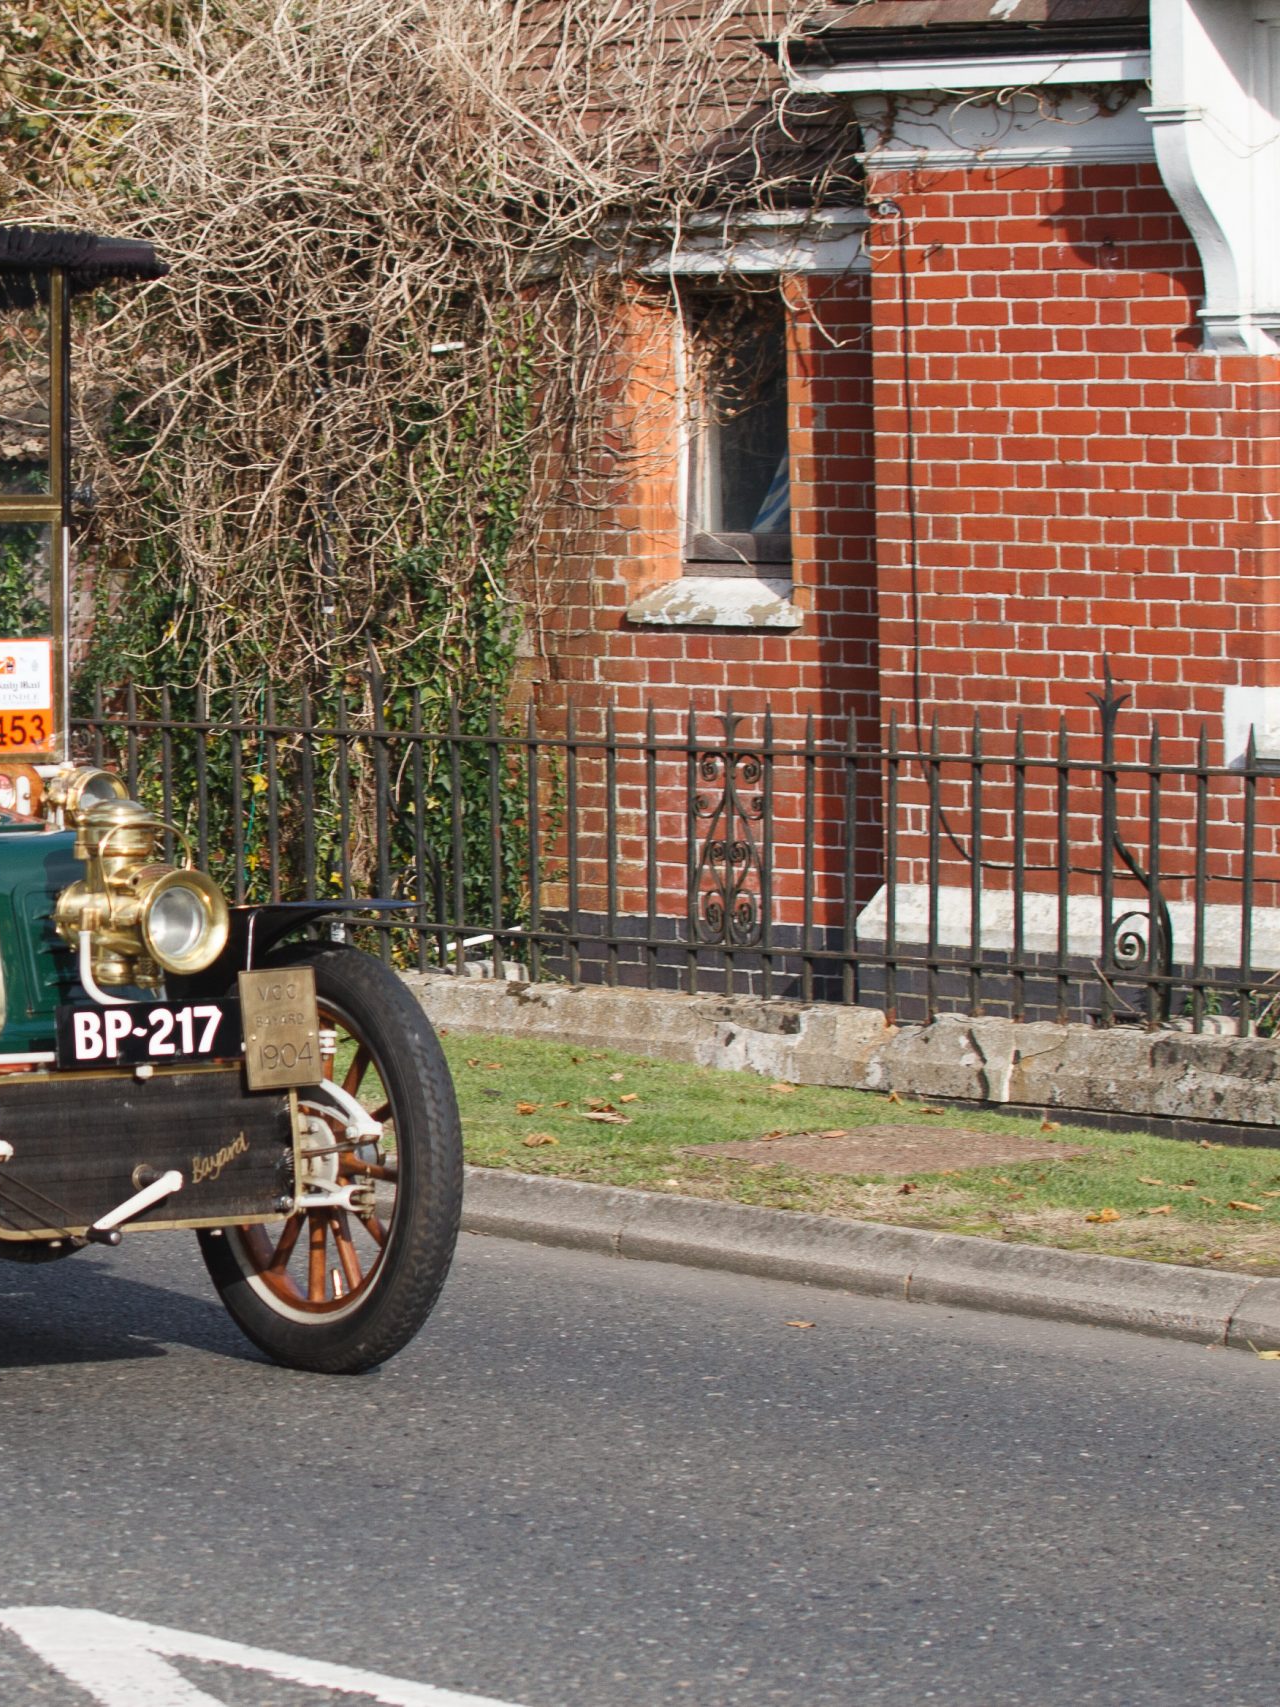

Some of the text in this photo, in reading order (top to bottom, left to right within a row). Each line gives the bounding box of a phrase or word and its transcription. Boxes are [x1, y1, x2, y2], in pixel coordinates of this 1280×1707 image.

[255, 1012, 305, 1028] BAYARD
[259, 1041, 314, 1072] 1904
[191, 1130, 251, 1185] Bayard
